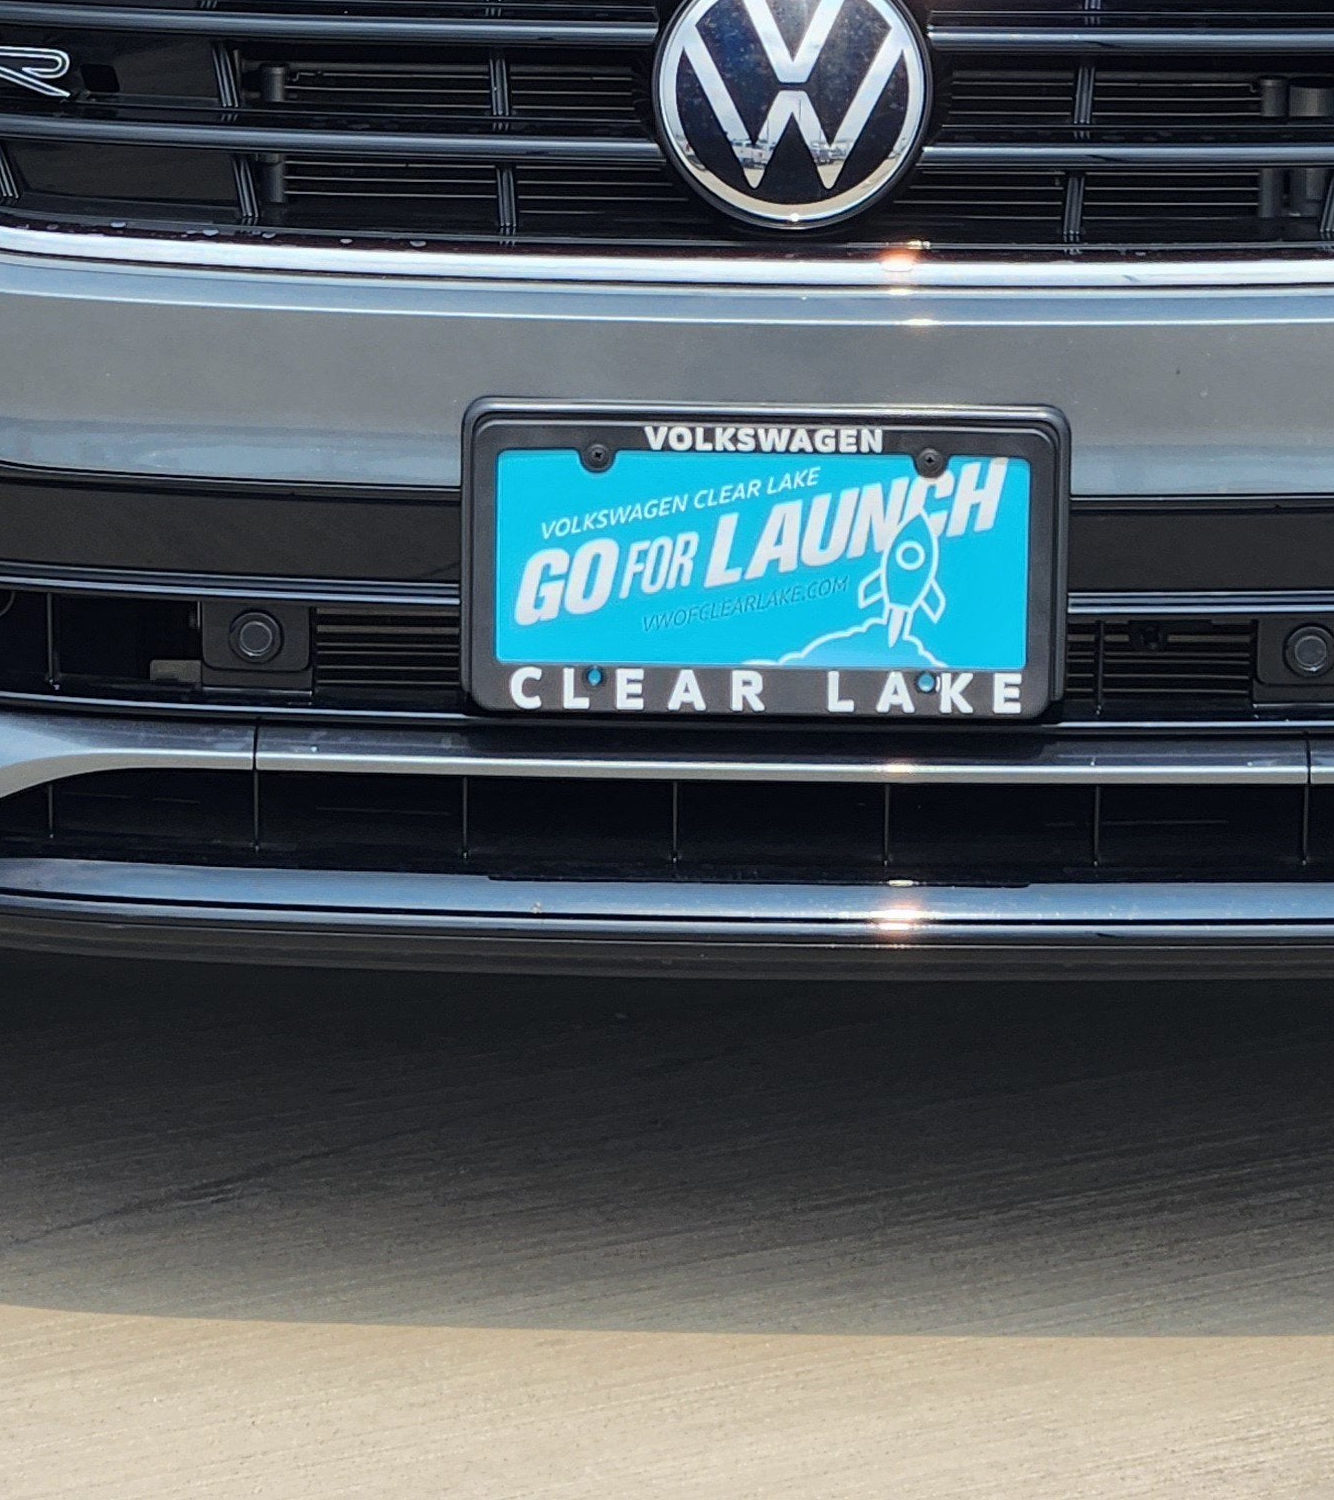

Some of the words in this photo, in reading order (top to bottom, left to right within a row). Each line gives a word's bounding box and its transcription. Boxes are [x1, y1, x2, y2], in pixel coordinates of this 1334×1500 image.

[644, 426, 884, 454] VOLKSWAGEN
[541, 494, 688, 540] VOLKSWAGEN
[693, 479, 762, 509] CLEAR
[767, 466, 821, 495] LAKE
[514, 537, 620, 626] GO
[619, 530, 700, 600] FOR
[703, 456, 1009, 589] LAUNCH
[509, 667, 766, 712] CLEAR
[827, 670, 1023, 714] LAKE
